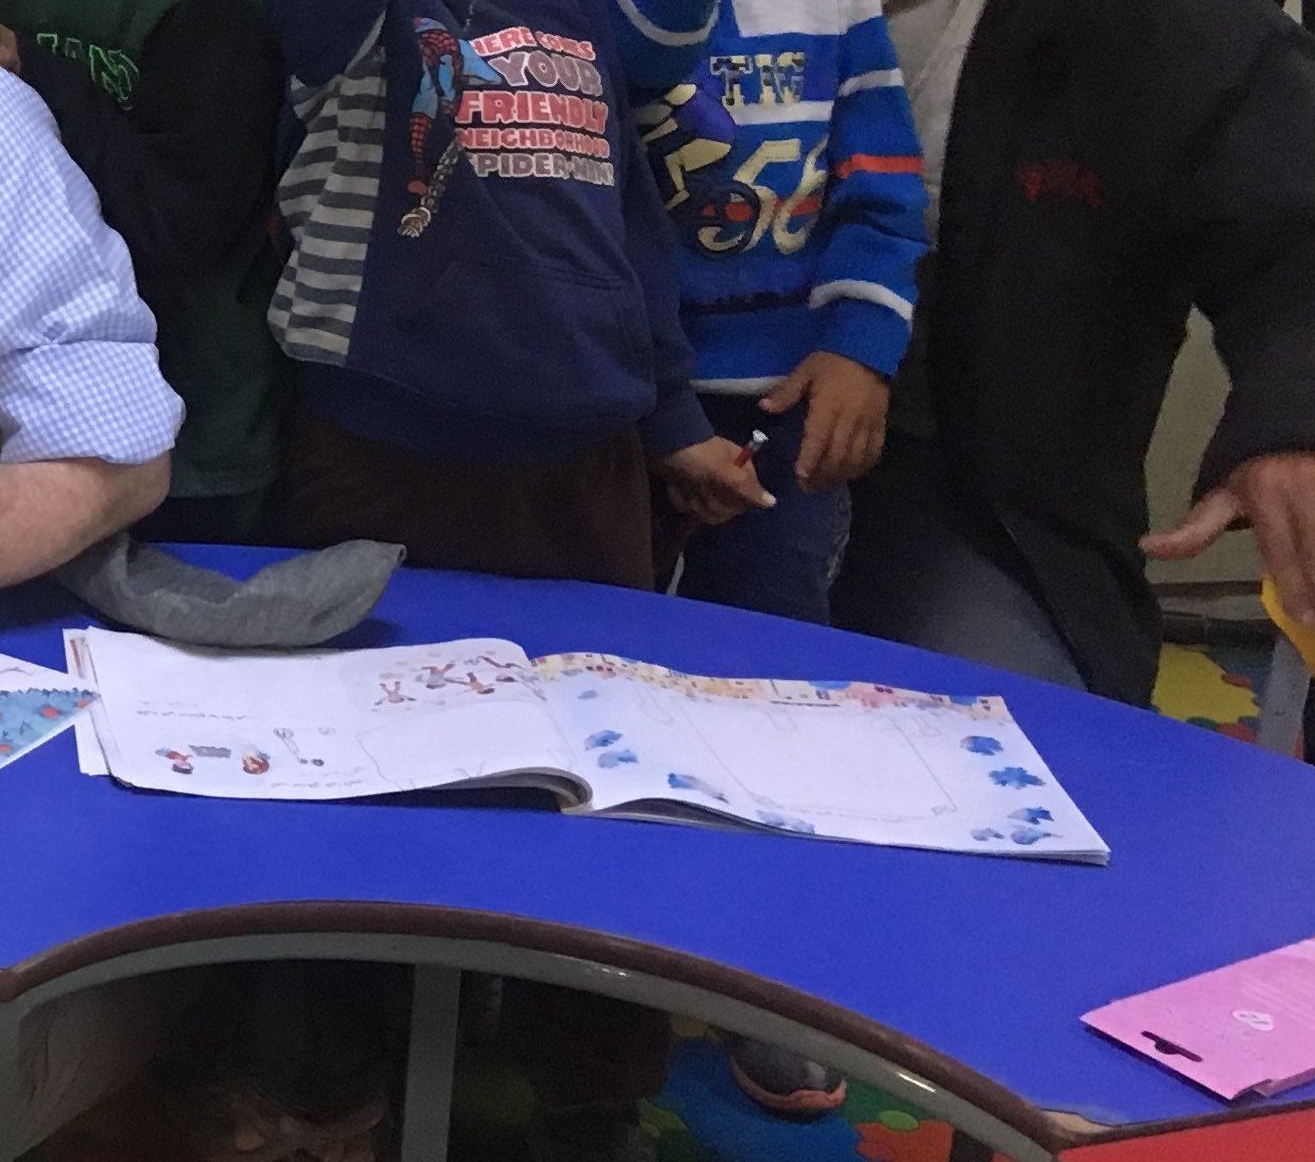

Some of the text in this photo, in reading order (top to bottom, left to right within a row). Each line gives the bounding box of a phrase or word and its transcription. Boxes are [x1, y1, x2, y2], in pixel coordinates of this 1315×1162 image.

[534, 30, 597, 61] COMES
[487, 49, 604, 97] YOUR
[454, 89, 610, 135] FRIENDLY
[455, 127, 611, 160] NEIGHBORHOOD
[696, 133, 830, 256] 56
